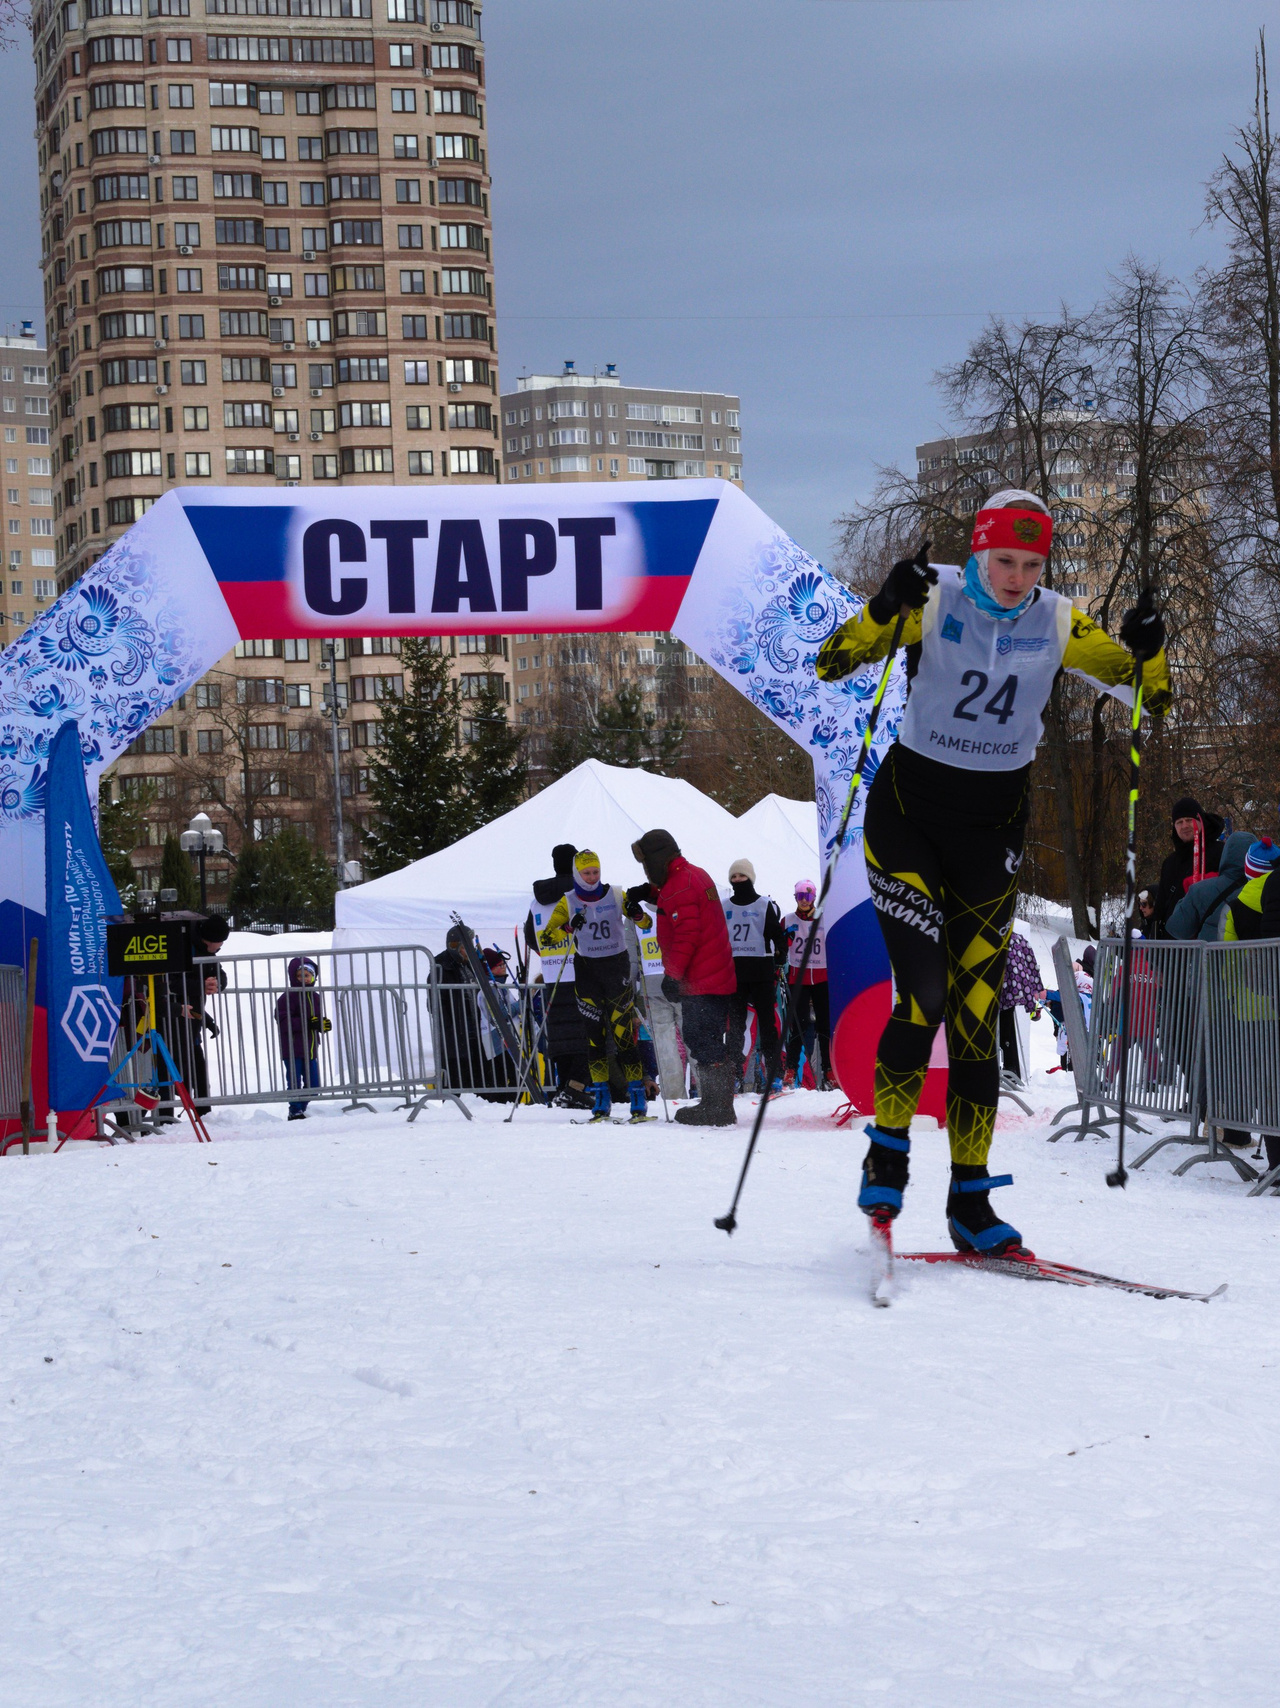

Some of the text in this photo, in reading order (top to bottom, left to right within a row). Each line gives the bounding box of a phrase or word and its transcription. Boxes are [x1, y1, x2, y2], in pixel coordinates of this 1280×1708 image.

[303, 517, 616, 616] СТАРТ
[952, 669, 1019, 725] 24
[929, 730, 1020, 755] РАМЕНСКОЕ
[74, 848, 96, 879] ОКРУГА
[65, 884, 79, 903] ПО
[905, 890, 945, 925] КЛУБ
[68, 905, 86, 975] КОМИТЕТ
[81, 886, 97, 974] АДМИНИСТРАЦИИ
[588, 920, 611, 941] 26
[733, 924, 750, 941] 27
[124, 934, 168, 954] ALGE
[587, 942, 620, 953] РАМЕНСКОЕ
[127, 953, 165, 961] TIMING
